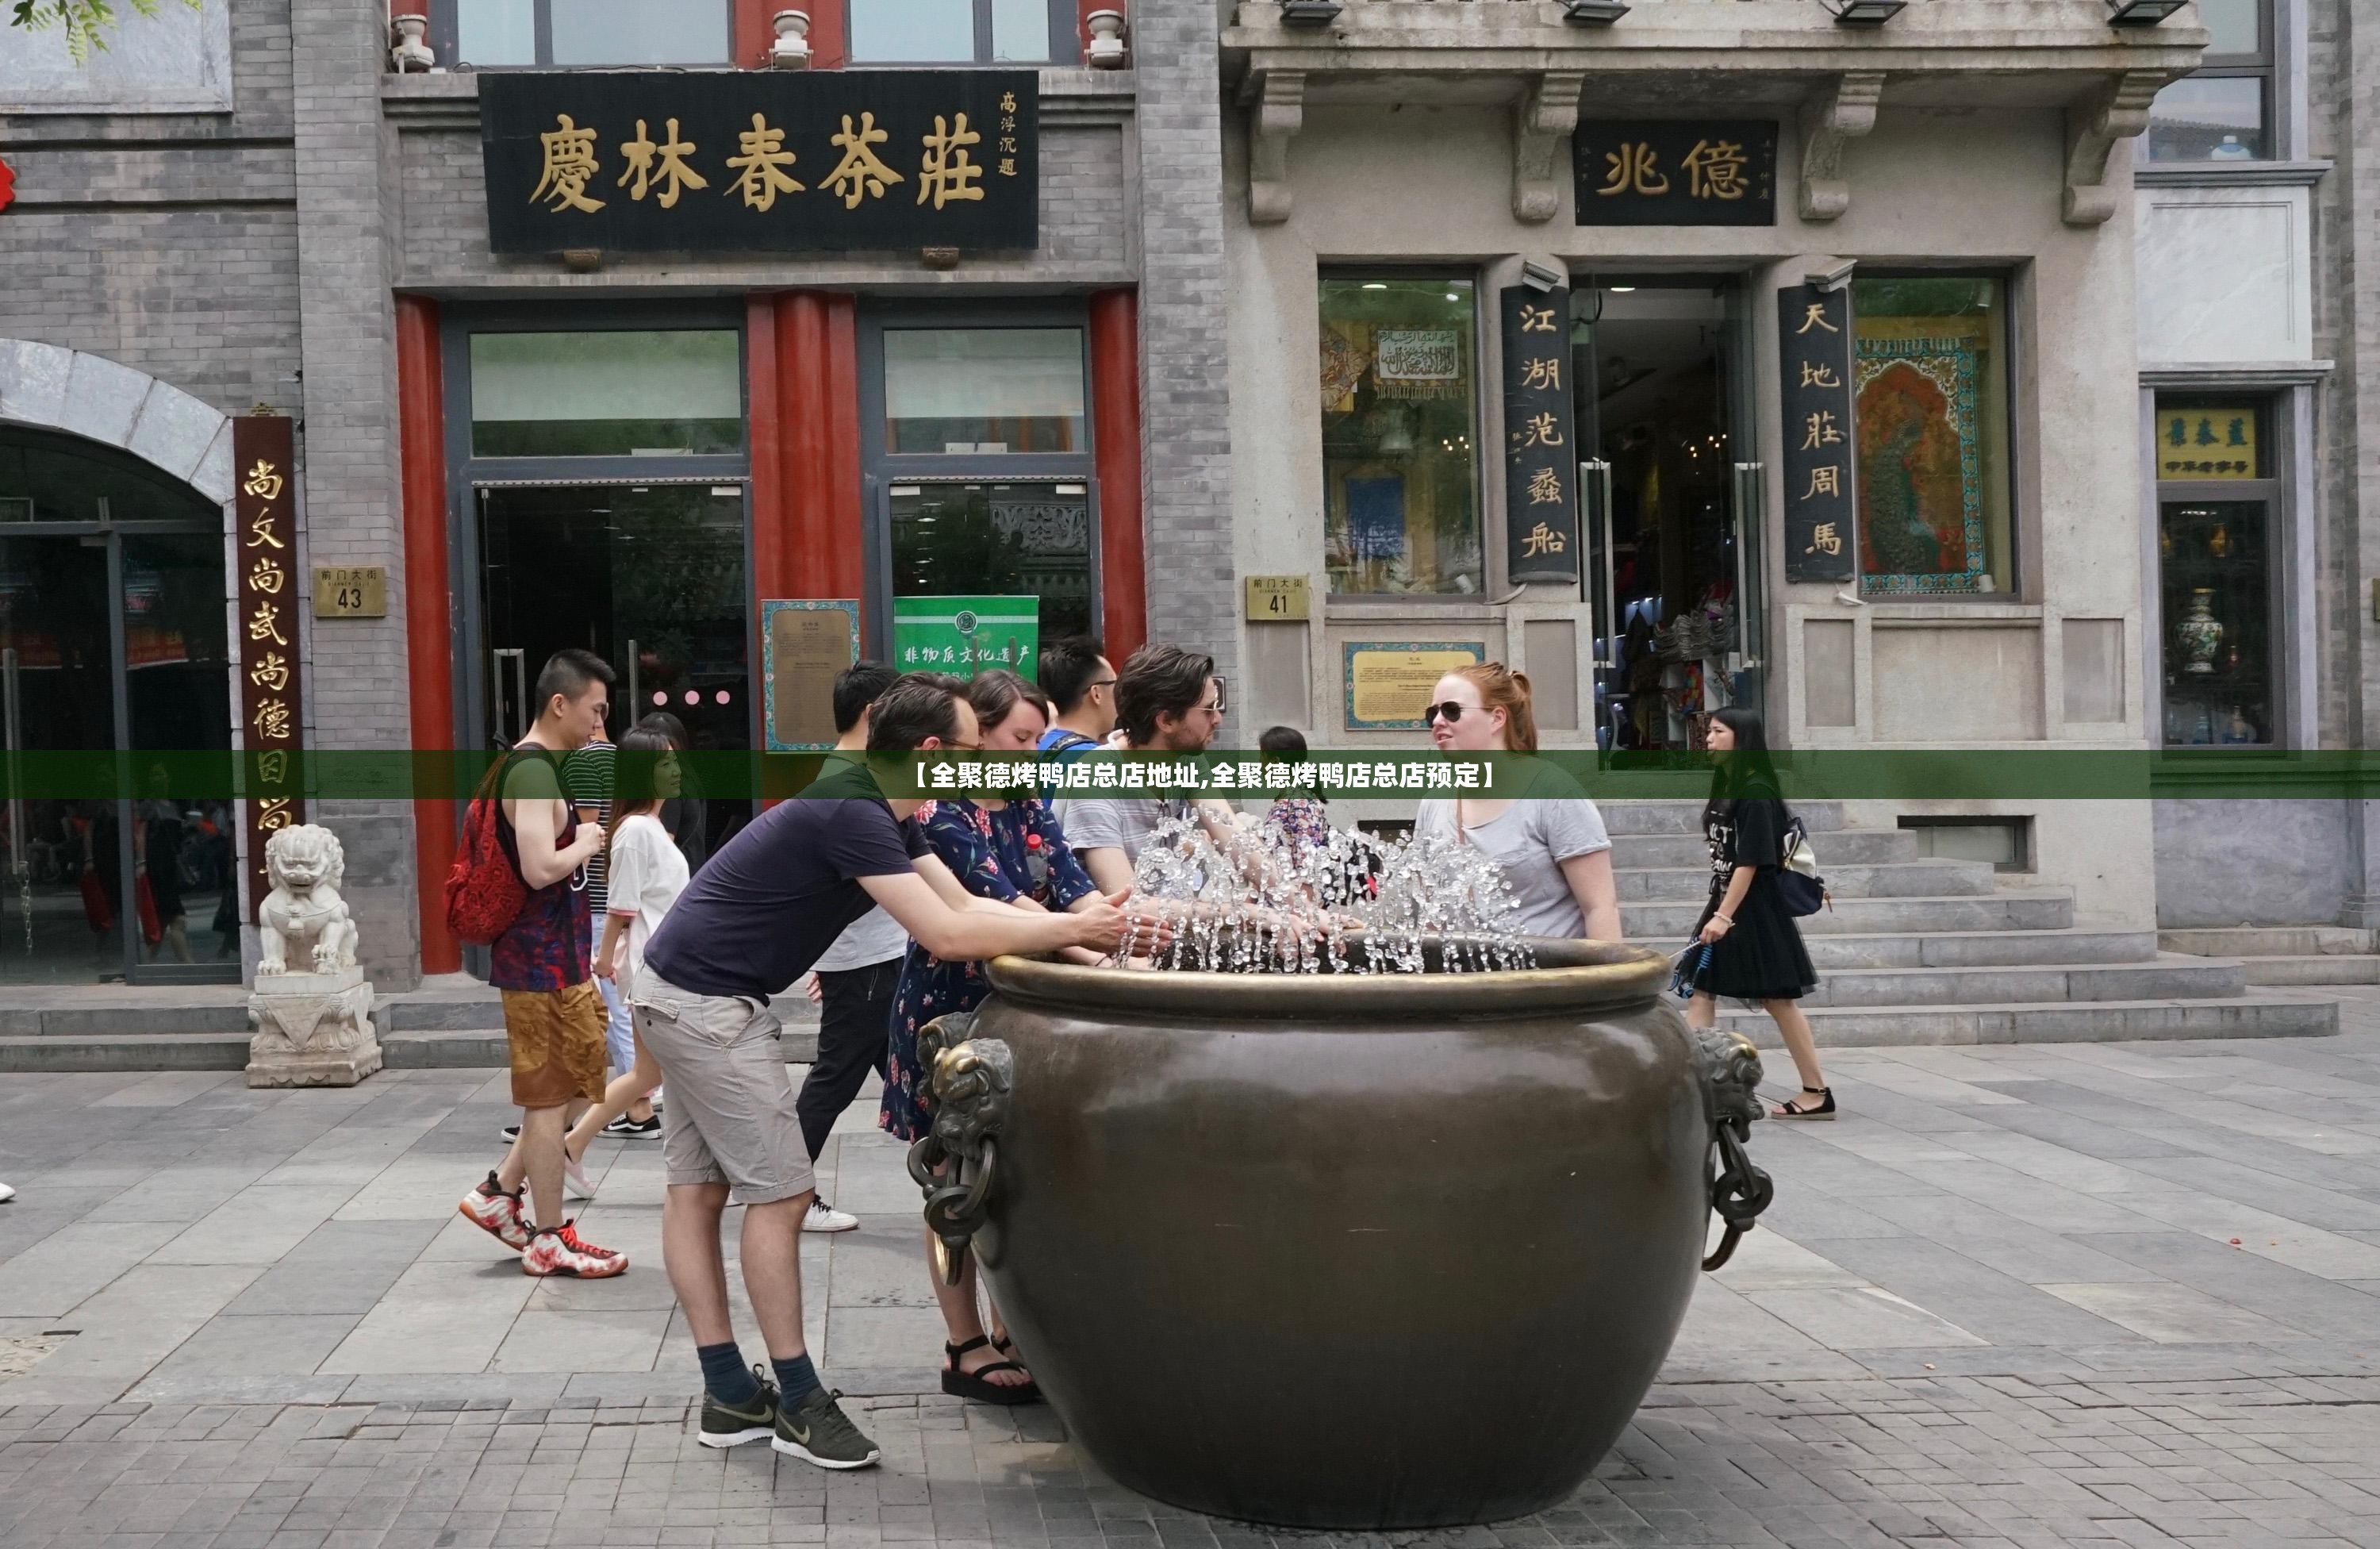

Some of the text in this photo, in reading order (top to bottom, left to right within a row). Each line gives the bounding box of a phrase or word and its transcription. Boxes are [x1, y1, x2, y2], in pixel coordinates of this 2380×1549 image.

[529, 113, 985, 213] 慶林春茶莊
[1520, 305, 1566, 558] 江湖范蠡船
[1796, 303, 1841, 555] 天地莊周馬
[321, 570, 377, 580] 前门大街
[1253, 578, 1303, 588] 前门大街
[338, 588, 362, 609] 43
[1269, 595, 1287, 613] 41
[904, 644, 1030, 666] 非物质文化遗产
